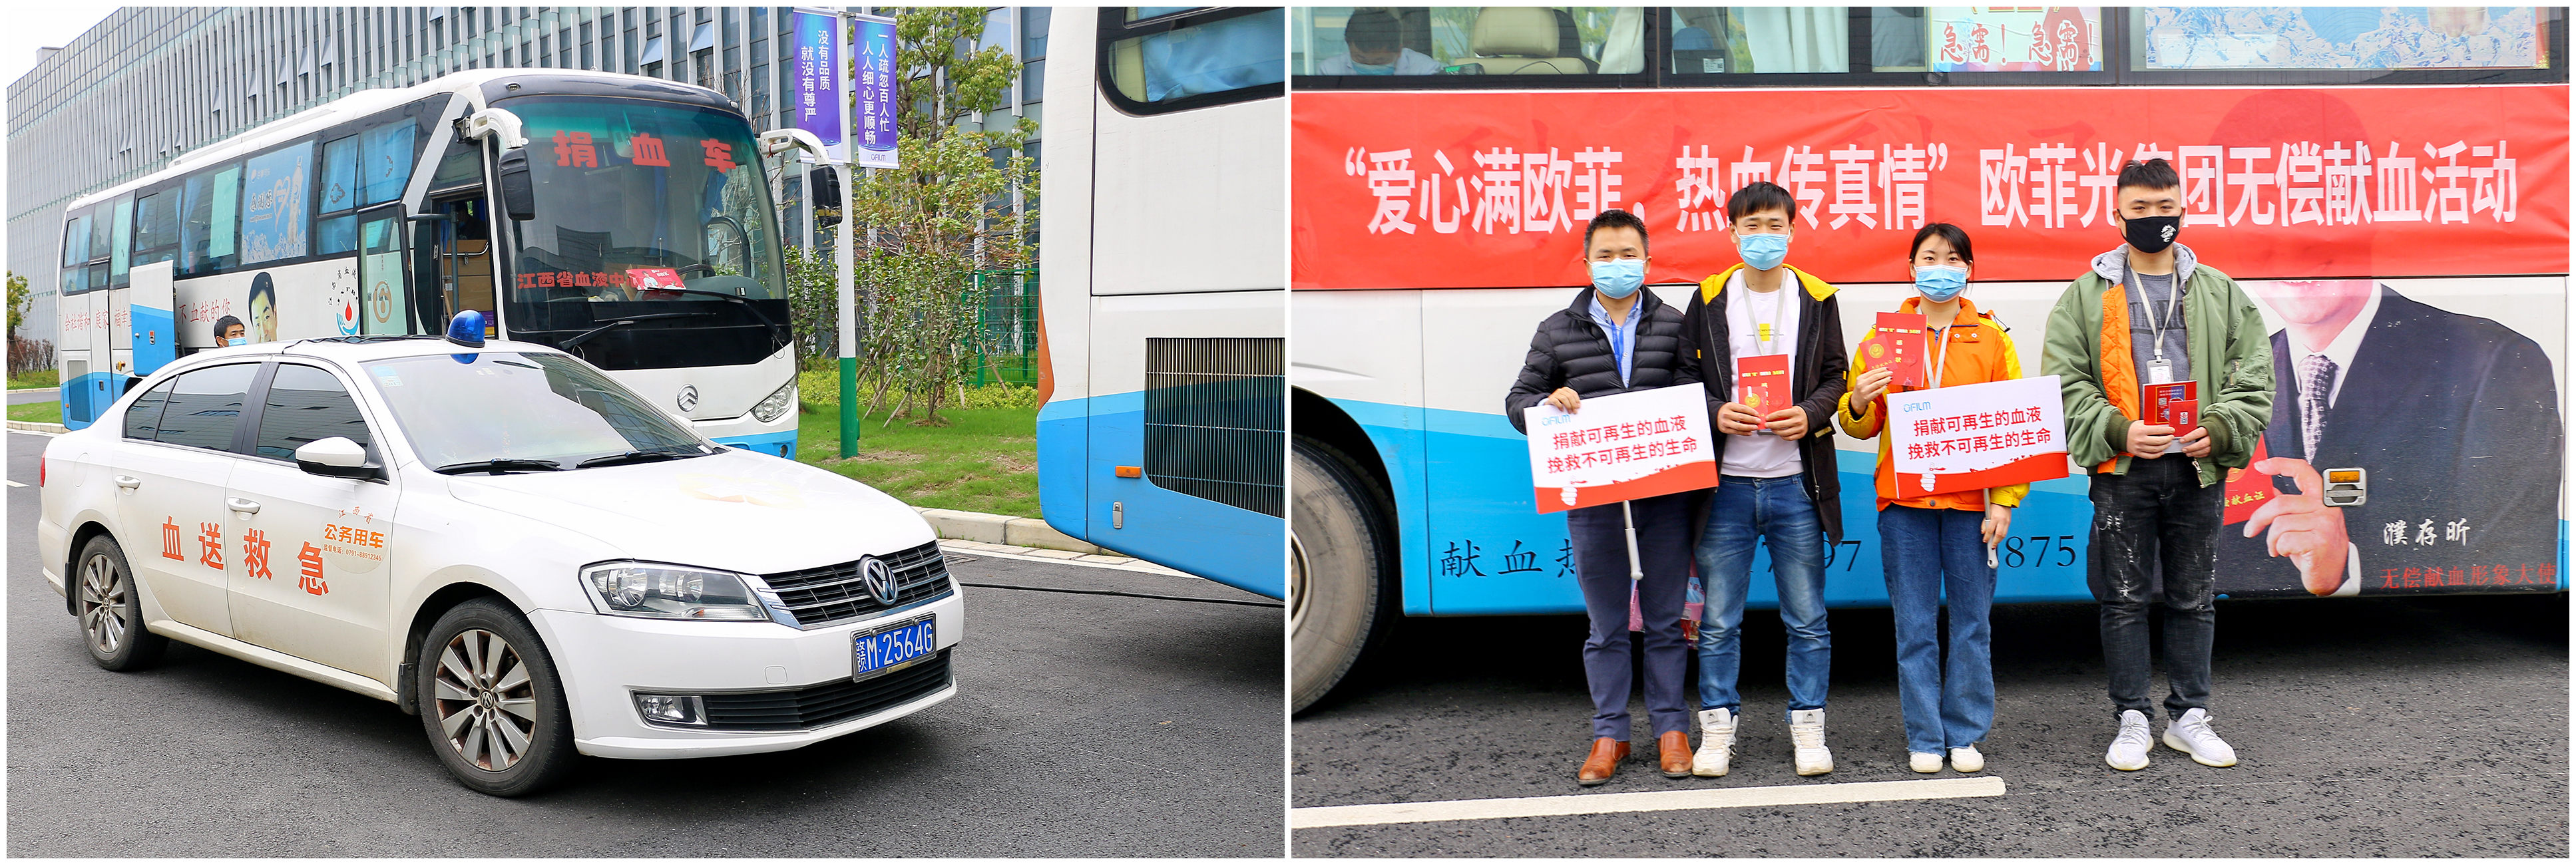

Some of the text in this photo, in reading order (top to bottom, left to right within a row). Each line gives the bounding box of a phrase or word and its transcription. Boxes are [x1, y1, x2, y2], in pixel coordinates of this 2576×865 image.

[818, 30, 831, 91] 没有品质
[1940, 23, 2006, 64] 急需！
[801, 46, 817, 122] 就没有尊严
[862, 41, 876, 145] 人人细心更顺畅
[877, 35, 890, 132] 一人疏忽百人忙
[552, 130, 737, 174] 捐血车
[1553, 415, 1687, 450] 捐献可再生的血液
[1914, 406, 2042, 437] 捐献可再生的血液
[1547, 436, 1697, 474] 挽救不可再生的生命
[1908, 427, 2051, 460] 挽救不可再生的生命
[338, 506, 373, 524] 江西省
[2383, 518, 2471, 546] 濮存昕
[324, 523, 384, 549] 公务用车
[2005, 535, 2076, 568] 875
[2380, 562, 2556, 590] 无偿献血形象大使
